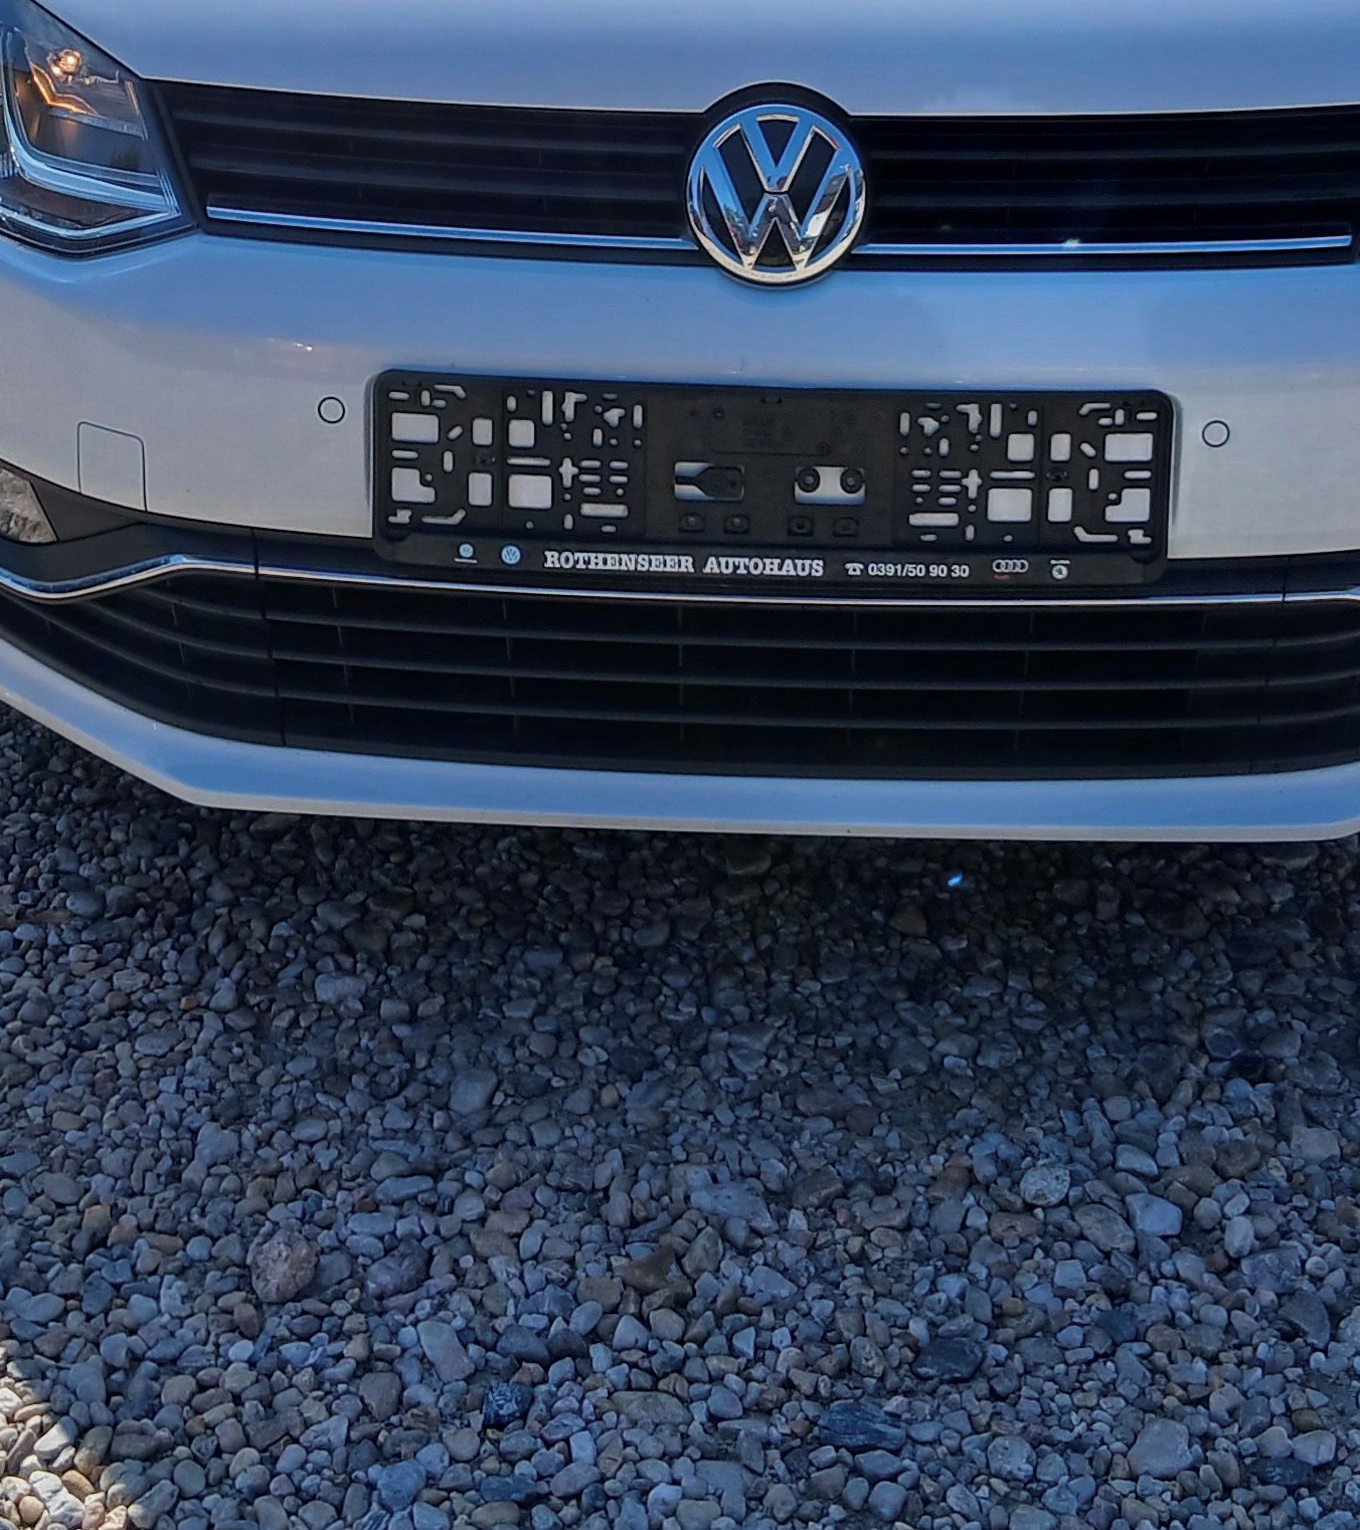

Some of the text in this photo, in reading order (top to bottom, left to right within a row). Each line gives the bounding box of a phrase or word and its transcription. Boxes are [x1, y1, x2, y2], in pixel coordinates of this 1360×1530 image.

[544, 550, 824, 578] ROTHENSEER AUTOHAUS
[867, 562, 970, 578] 0391/50 90 30
